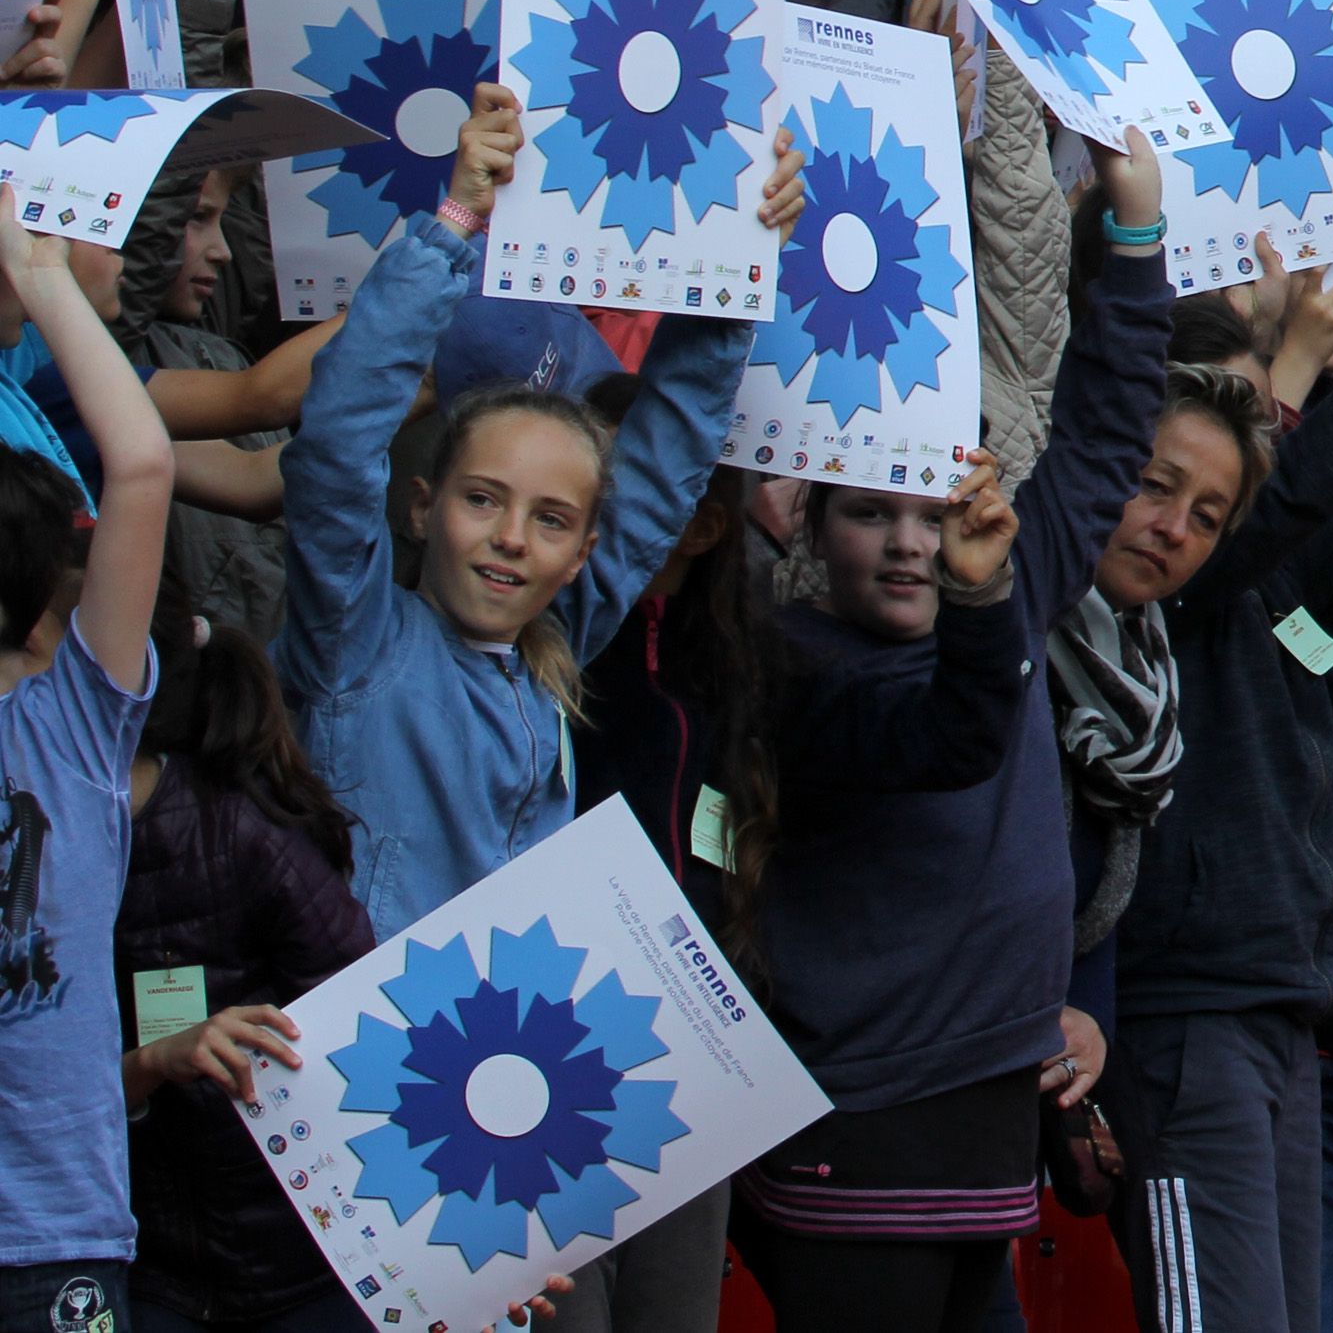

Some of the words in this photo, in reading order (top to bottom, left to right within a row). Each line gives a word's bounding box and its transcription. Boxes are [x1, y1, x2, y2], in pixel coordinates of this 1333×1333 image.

[816, 24, 873, 45] rennes
[615, 903, 634, 925] Pour
[630, 927, 644, 945] une
[642, 944, 674, 985] mémoire
[669, 984, 699, 1023] solidaire
[699, 1032, 732, 1075] citoyenne
[618, 889, 634, 910] Ville
[639, 924, 666, 960] Rennes,
[662, 960, 698, 1008] partenaire
[703, 1018, 725, 1047] Bleuet
[731, 1059, 754, 1088] France
[675, 950, 691, 970] VIVRE
[696, 983, 732, 1029] INTELLIGENCE
[684, 940, 746, 1022] rennes
